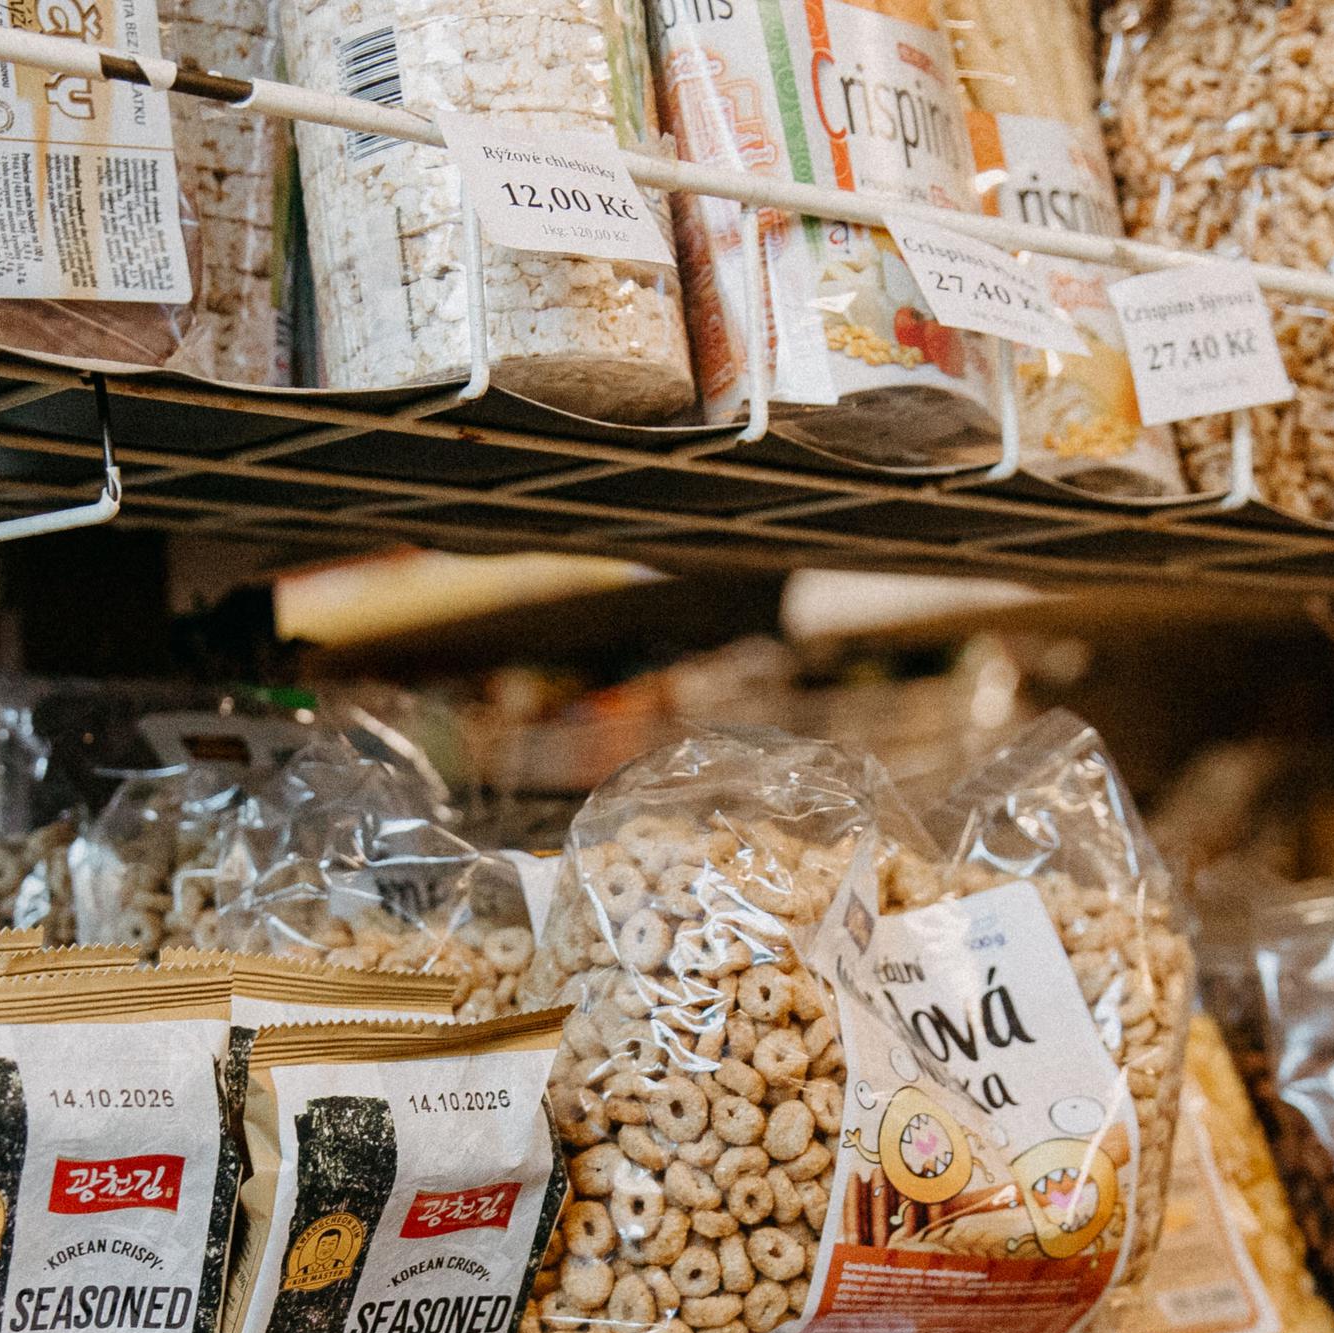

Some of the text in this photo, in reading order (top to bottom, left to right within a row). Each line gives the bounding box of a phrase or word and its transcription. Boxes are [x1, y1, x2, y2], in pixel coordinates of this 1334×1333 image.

[482, 145, 617, 182] Rýžové chlebíčky
[500, 181, 639, 221] 12,00 Kč
[928, 269, 1012, 306] 27,40
[1144, 333, 1221, 372] 27,40
[49, 1088, 176, 1109] 14.10.2026
[408, 1089, 512, 1114] 14.10.2026
[63, 1163, 168, 1204] 광천김
[417, 1191, 507, 1227] 광천김
[46, 1238, 164, 1271] KOREAN CRISPY
[390, 1255, 490, 1287] KOREAN CRISPY
[311, 1268, 345, 1282] MASTER
[8, 1283, 193, 1333] SEASONED
